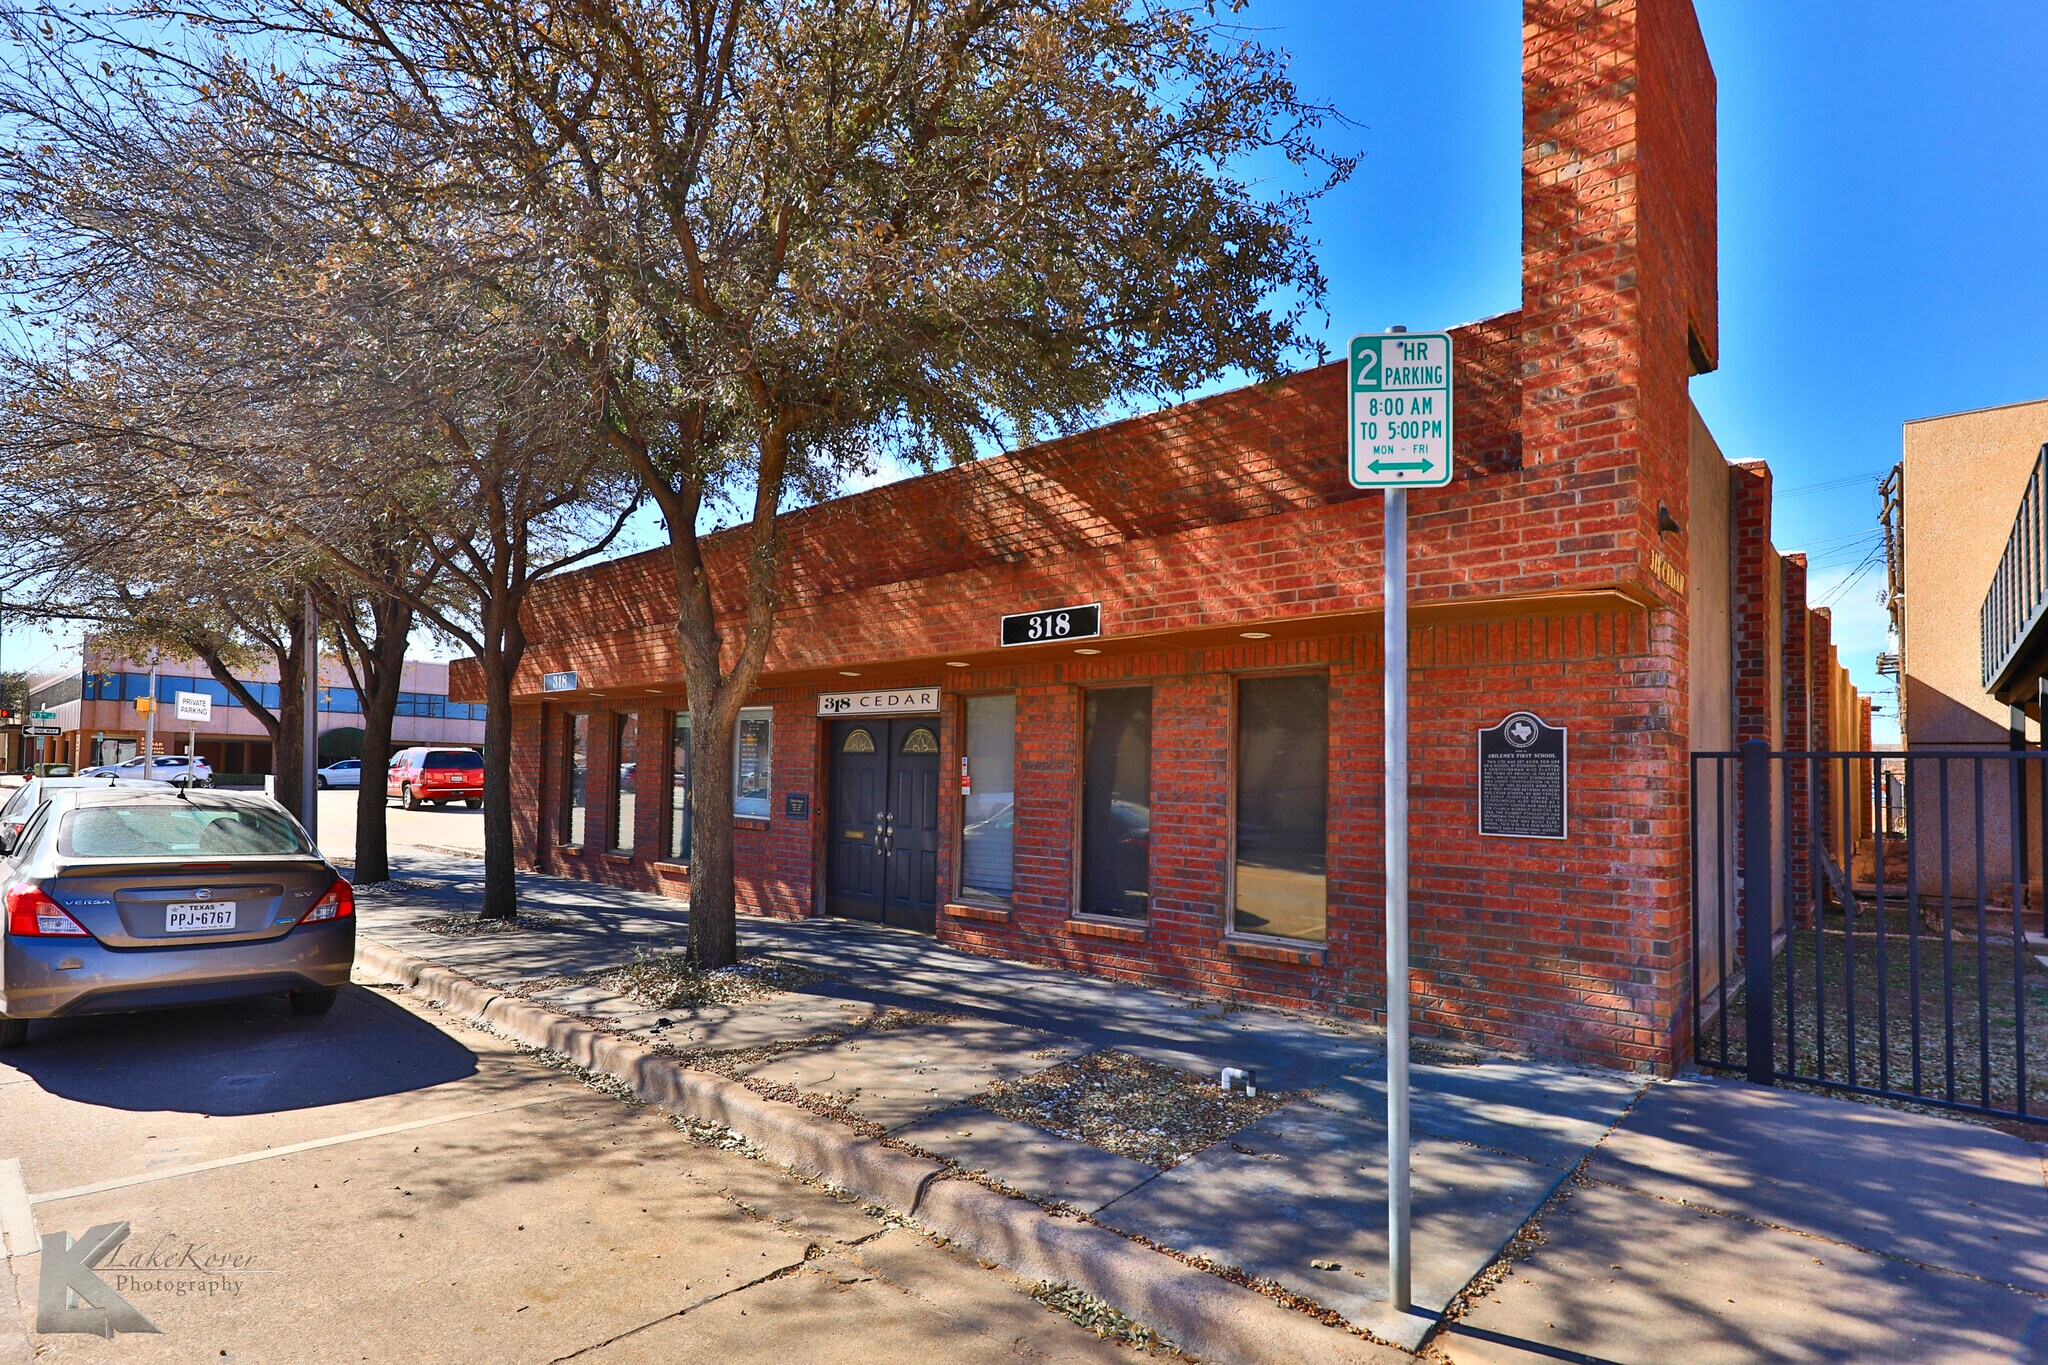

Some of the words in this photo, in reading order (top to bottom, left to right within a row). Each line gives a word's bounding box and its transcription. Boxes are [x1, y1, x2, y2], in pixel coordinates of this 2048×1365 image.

[1357, 349, 1378, 385] 2
[1403, 342, 1428, 361] HR
[1385, 365, 1443, 386] PARKING
[1369, 397, 1404, 417] 8:00
[1410, 397, 1433, 415] AM
[1360, 422, 1377, 440] TO
[1373, 445, 1394, 455] MON
[1413, 444, 1429, 454] FRI
[1028, 612, 1071, 639] 318
[552, 674, 568, 689] 318
[181, 706, 208, 716] PARKING
[182, 697, 207, 707] PRIVATE
[824, 697, 851, 713] 318
[860, 693, 931, 707] CEDAR
